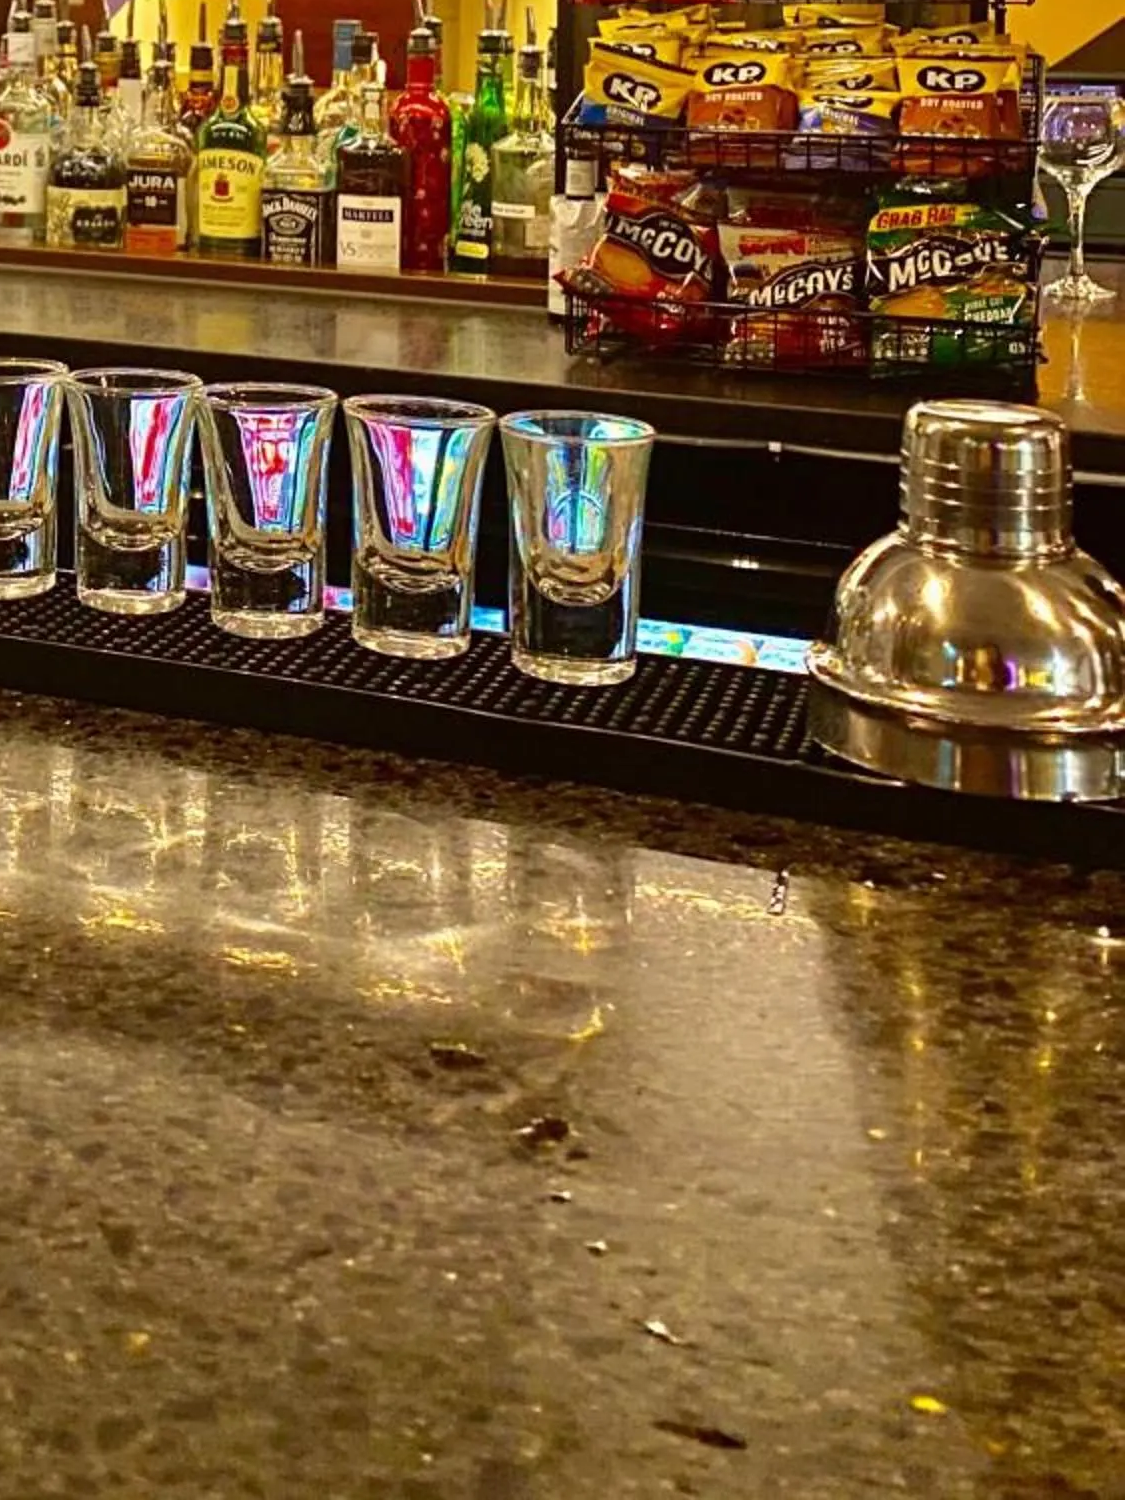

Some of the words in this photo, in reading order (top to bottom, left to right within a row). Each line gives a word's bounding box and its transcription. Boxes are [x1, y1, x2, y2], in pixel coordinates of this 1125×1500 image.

[711, 65, 763, 84] KP
[926, 69, 979, 90] KP
[609, 76, 658, 112] KP
[128, 175, 175, 189] JURA
[876, 208, 923, 229] GRAB
[926, 206, 957, 225] BAG
